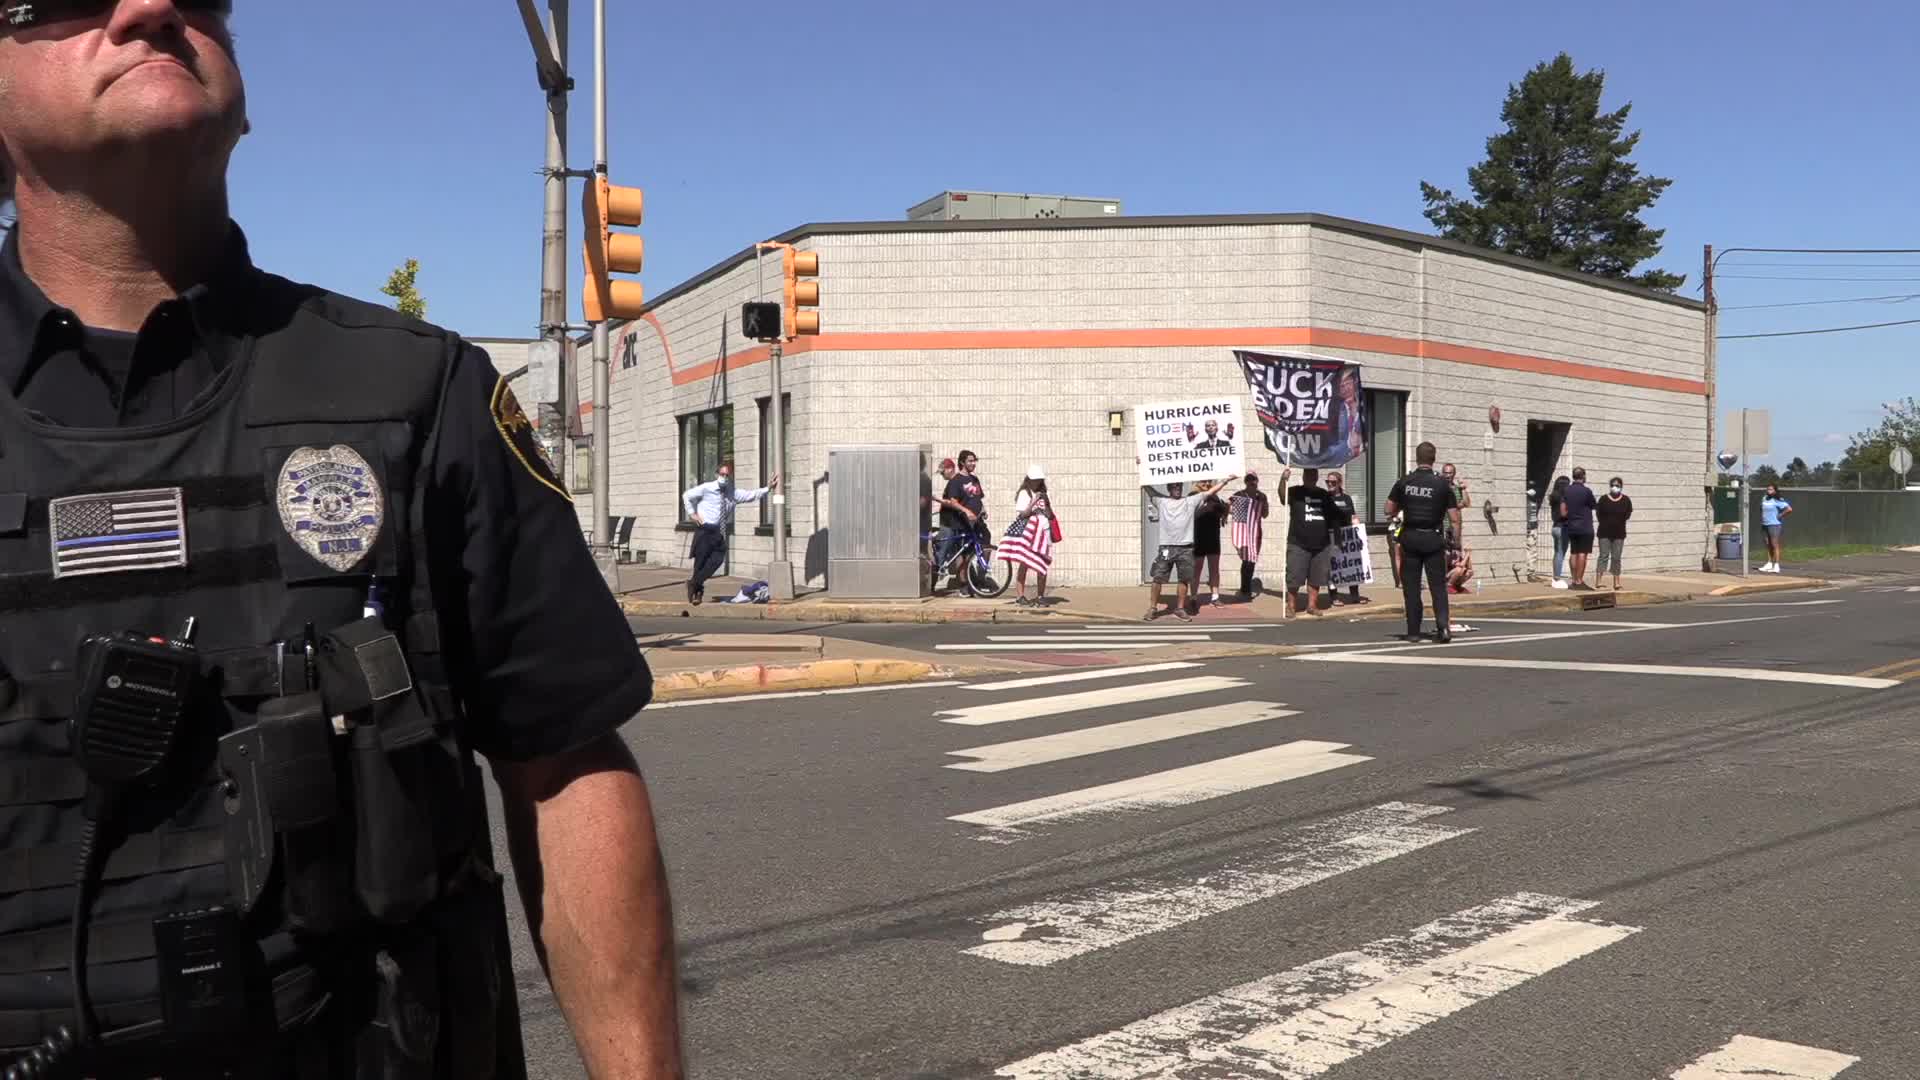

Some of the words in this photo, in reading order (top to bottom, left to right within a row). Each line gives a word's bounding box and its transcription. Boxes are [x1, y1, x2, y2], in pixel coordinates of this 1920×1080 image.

[1251, 385, 1330, 420] BDEN
[1144, 403, 1232, 421] HURRICANE
[1146, 422, 1192, 435] BIDEN
[1147, 438, 1183, 449] MORE
[1148, 446, 1236, 462] DESTRUCTIVE
[1149, 465, 1184, 476] THAN
[1188, 462, 1214, 473] IDA!
[1405, 485, 1433, 498] POLICE
